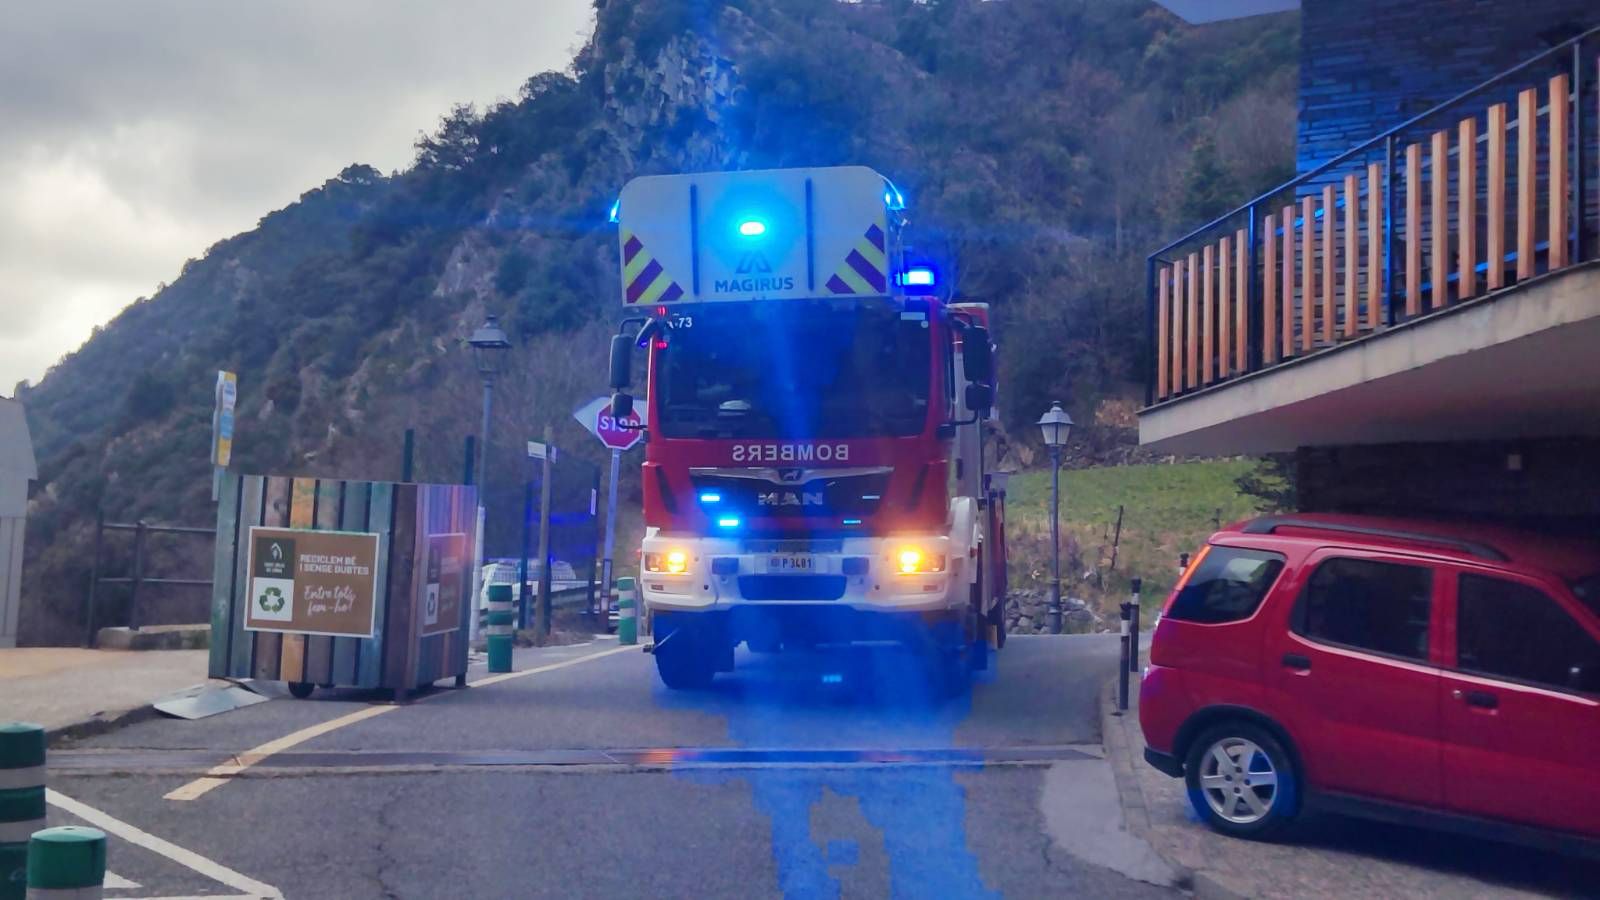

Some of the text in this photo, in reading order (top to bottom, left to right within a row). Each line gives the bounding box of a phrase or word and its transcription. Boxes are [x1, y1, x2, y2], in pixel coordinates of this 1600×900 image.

[714, 277, 794, 293] MAGIRUS
[599, 415, 639, 434] STOP
[758, 492, 823, 505] MAN
[300, 554, 343, 565] RECICLEM
[304, 585, 332, 600] Entre
